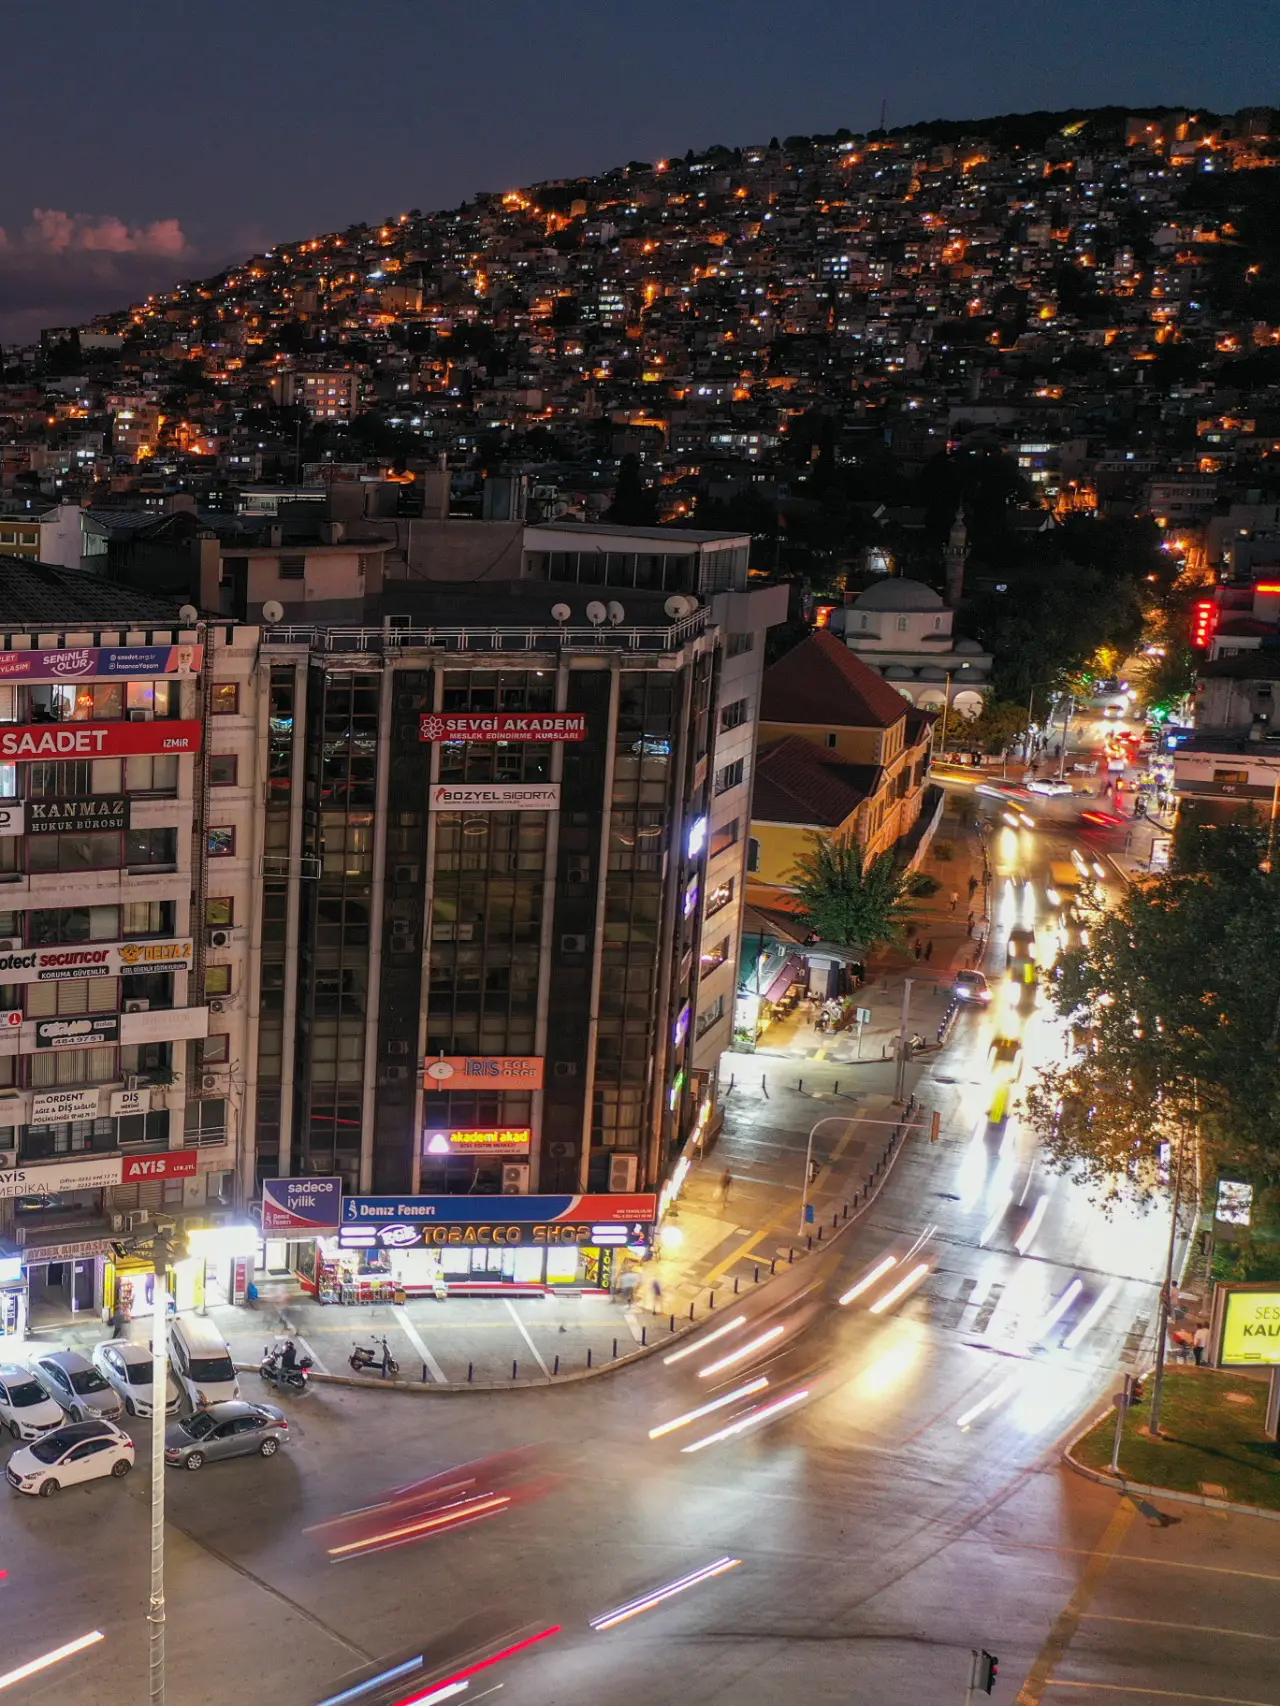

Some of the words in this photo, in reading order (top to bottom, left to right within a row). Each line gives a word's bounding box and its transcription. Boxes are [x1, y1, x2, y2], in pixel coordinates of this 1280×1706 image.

[57, 659, 87, 671] OLUR
[446, 716, 498, 730] SEVGİ
[505, 716, 585, 730] AKADEMİ
[2, 730, 108, 755] SAADET
[443, 791, 500, 800] BOZYEL
[31, 801, 124, 818] KANMAZ
[31, 821, 73, 831] HUKUK
[76, 818, 124, 829] BÜROSU
[145, 944, 180, 960] DELTA
[183, 943, 192, 958] 2
[73, 968, 106, 977] GÜVENLİK
[503, 1069, 537, 1077] OSGB
[46, 1093, 84, 1103] ORDENT
[122, 1093, 139, 1104] DİŞ
[58, 1103, 72, 1113] DİŞ
[450, 1131, 498, 1142] akademi
[288, 1182, 333, 1193] sadece
[287, 1196, 315, 1209] iyilik
[422, 1226, 520, 1245] TOBACCO
[532, 1226, 592, 1244] SHOP
